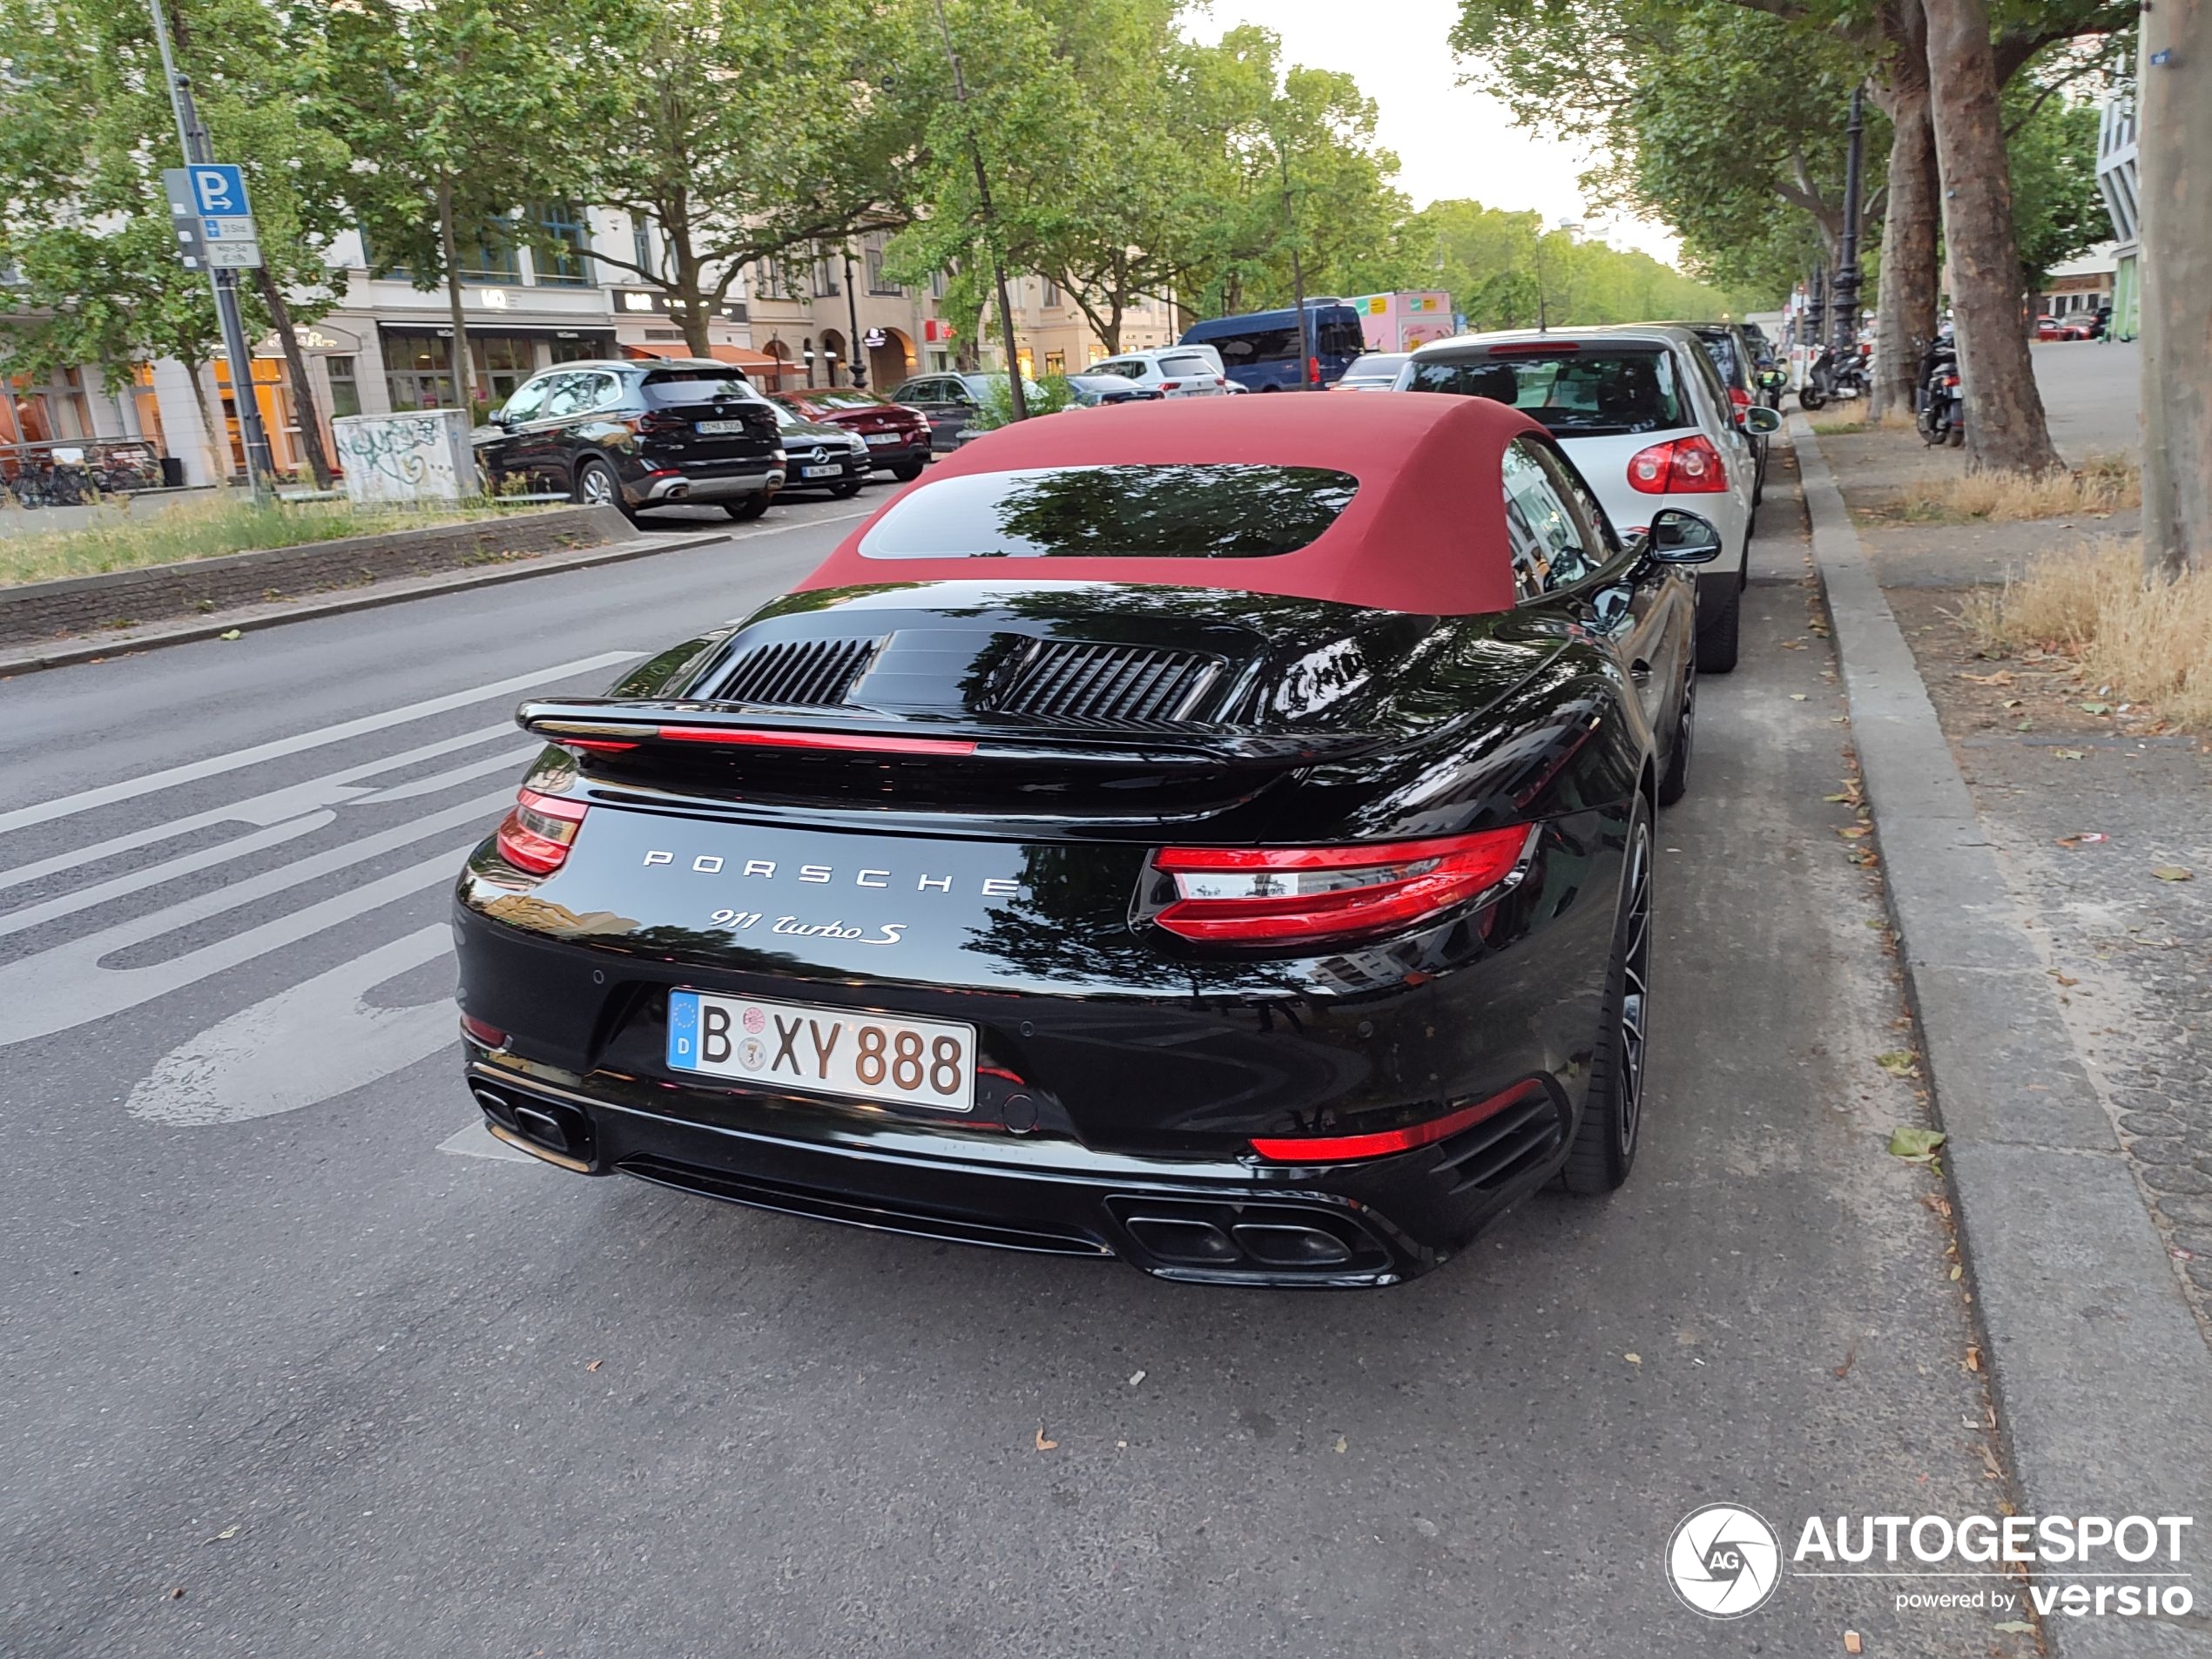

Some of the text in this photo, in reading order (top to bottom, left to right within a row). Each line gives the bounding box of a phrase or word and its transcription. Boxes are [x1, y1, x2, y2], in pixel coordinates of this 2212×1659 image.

[196, 171, 228, 210] P
[643, 850, 1020, 897] PORSCHE
[710, 908, 907, 946] 911 turbo S
[678, 1037, 690, 1055] D
[703, 1005, 731, 1063] B
[771, 1014, 842, 1079] XY
[855, 1026, 961, 1096] 888
